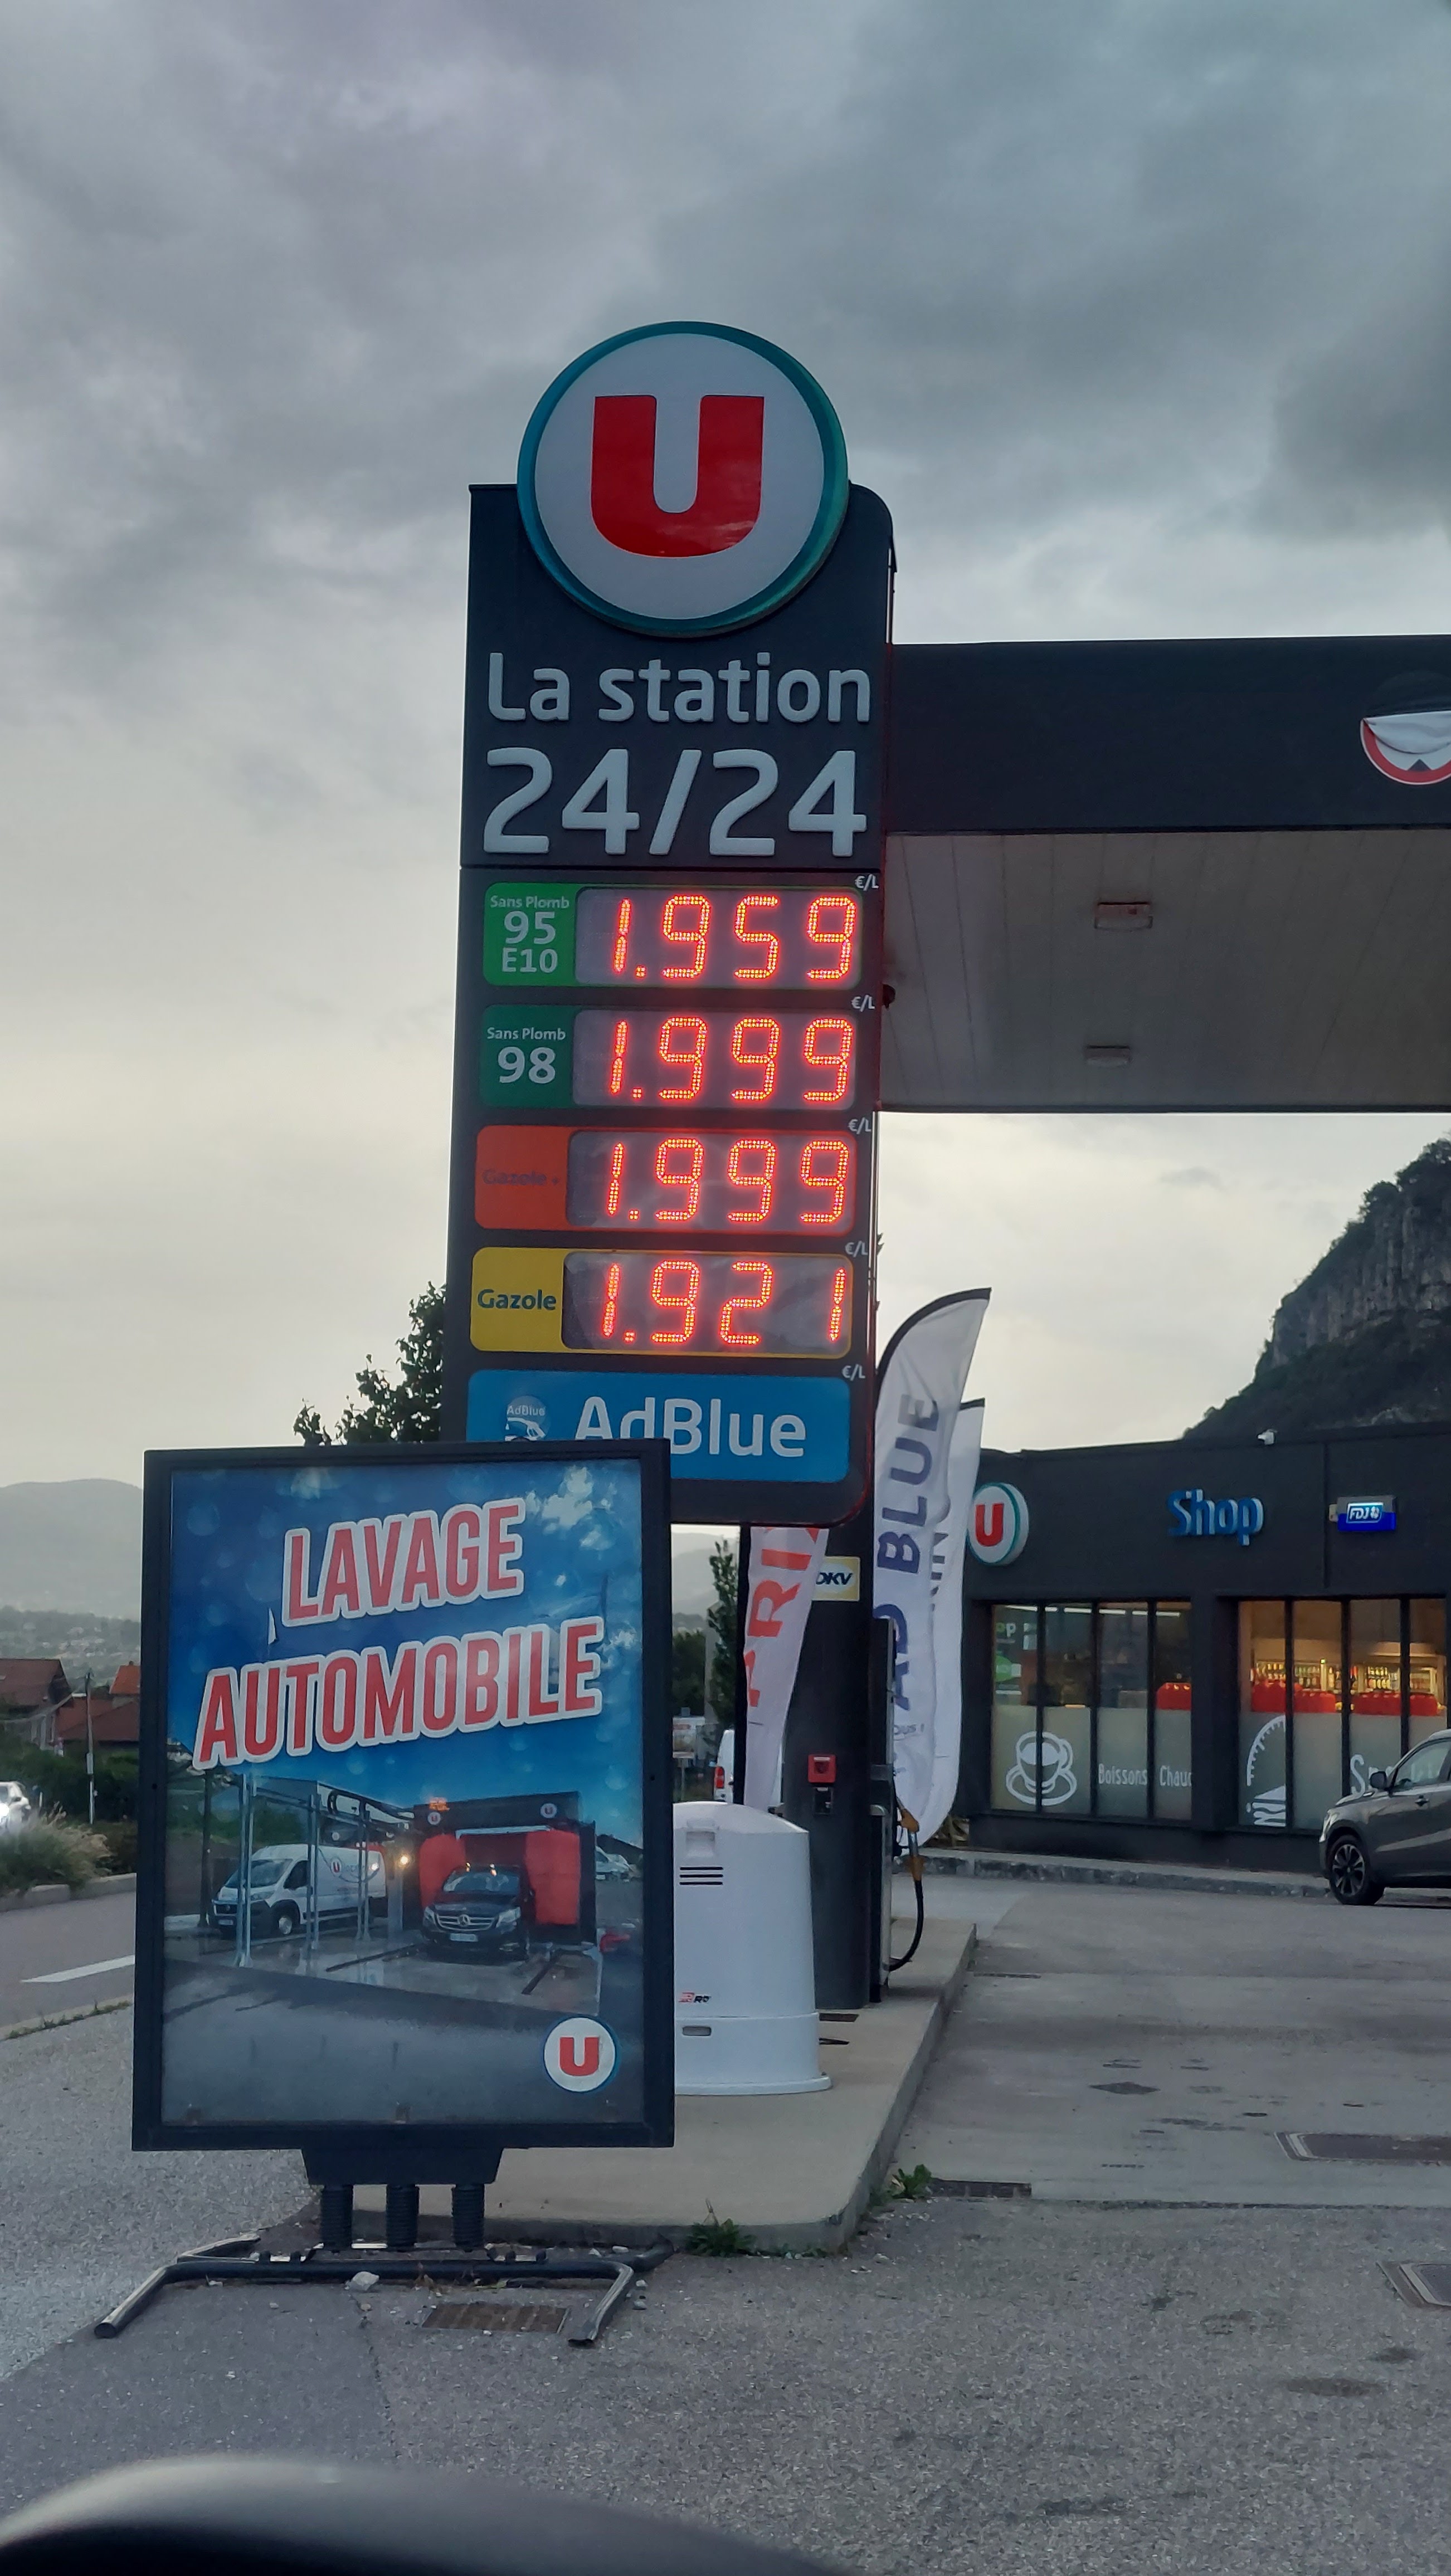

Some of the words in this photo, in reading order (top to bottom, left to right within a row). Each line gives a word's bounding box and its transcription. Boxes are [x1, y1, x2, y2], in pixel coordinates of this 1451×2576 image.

[590, 394, 765, 558] U
[488, 652, 570, 721] La
[598, 652, 870, 723] station
[483, 747, 867, 857] 24/24
[490, 896, 522, 909] Sans
[525, 896, 569, 910] Plomb
[855, 875, 879, 890] €/L
[504, 910, 556, 945] 95
[613, 894, 856, 980] 1.959
[502, 948, 558, 973] E10
[851, 996, 875, 1011] €/L
[486, 1027, 519, 1040] Sans
[522, 1027, 566, 1041] Plomb
[498, 1047, 556, 1084] 98
[610, 1017, 853, 1102] 1.999
[606, 1138, 849, 1223] 1.999
[477, 1288, 557, 1311] Gazole
[602, 1260, 847, 1345] 1.921
[842, 1365, 865, 1379] €/L
[575, 1396, 806, 1457] AdBlue
[877, 1394, 939, 1574] BLUE
[975, 1503, 1004, 1546] U
[1167, 1489, 1264, 1546] Shop
[1349, 1507, 1370, 1520] FDJ
[282, 1497, 526, 1627] LAVAGE
[816, 1572, 853, 1585] DKV
[193, 1616, 603, 1770] AUTOMOBILE
[1098, 1763, 1147, 1785] Boissons
[559, 2037, 600, 2076] U
